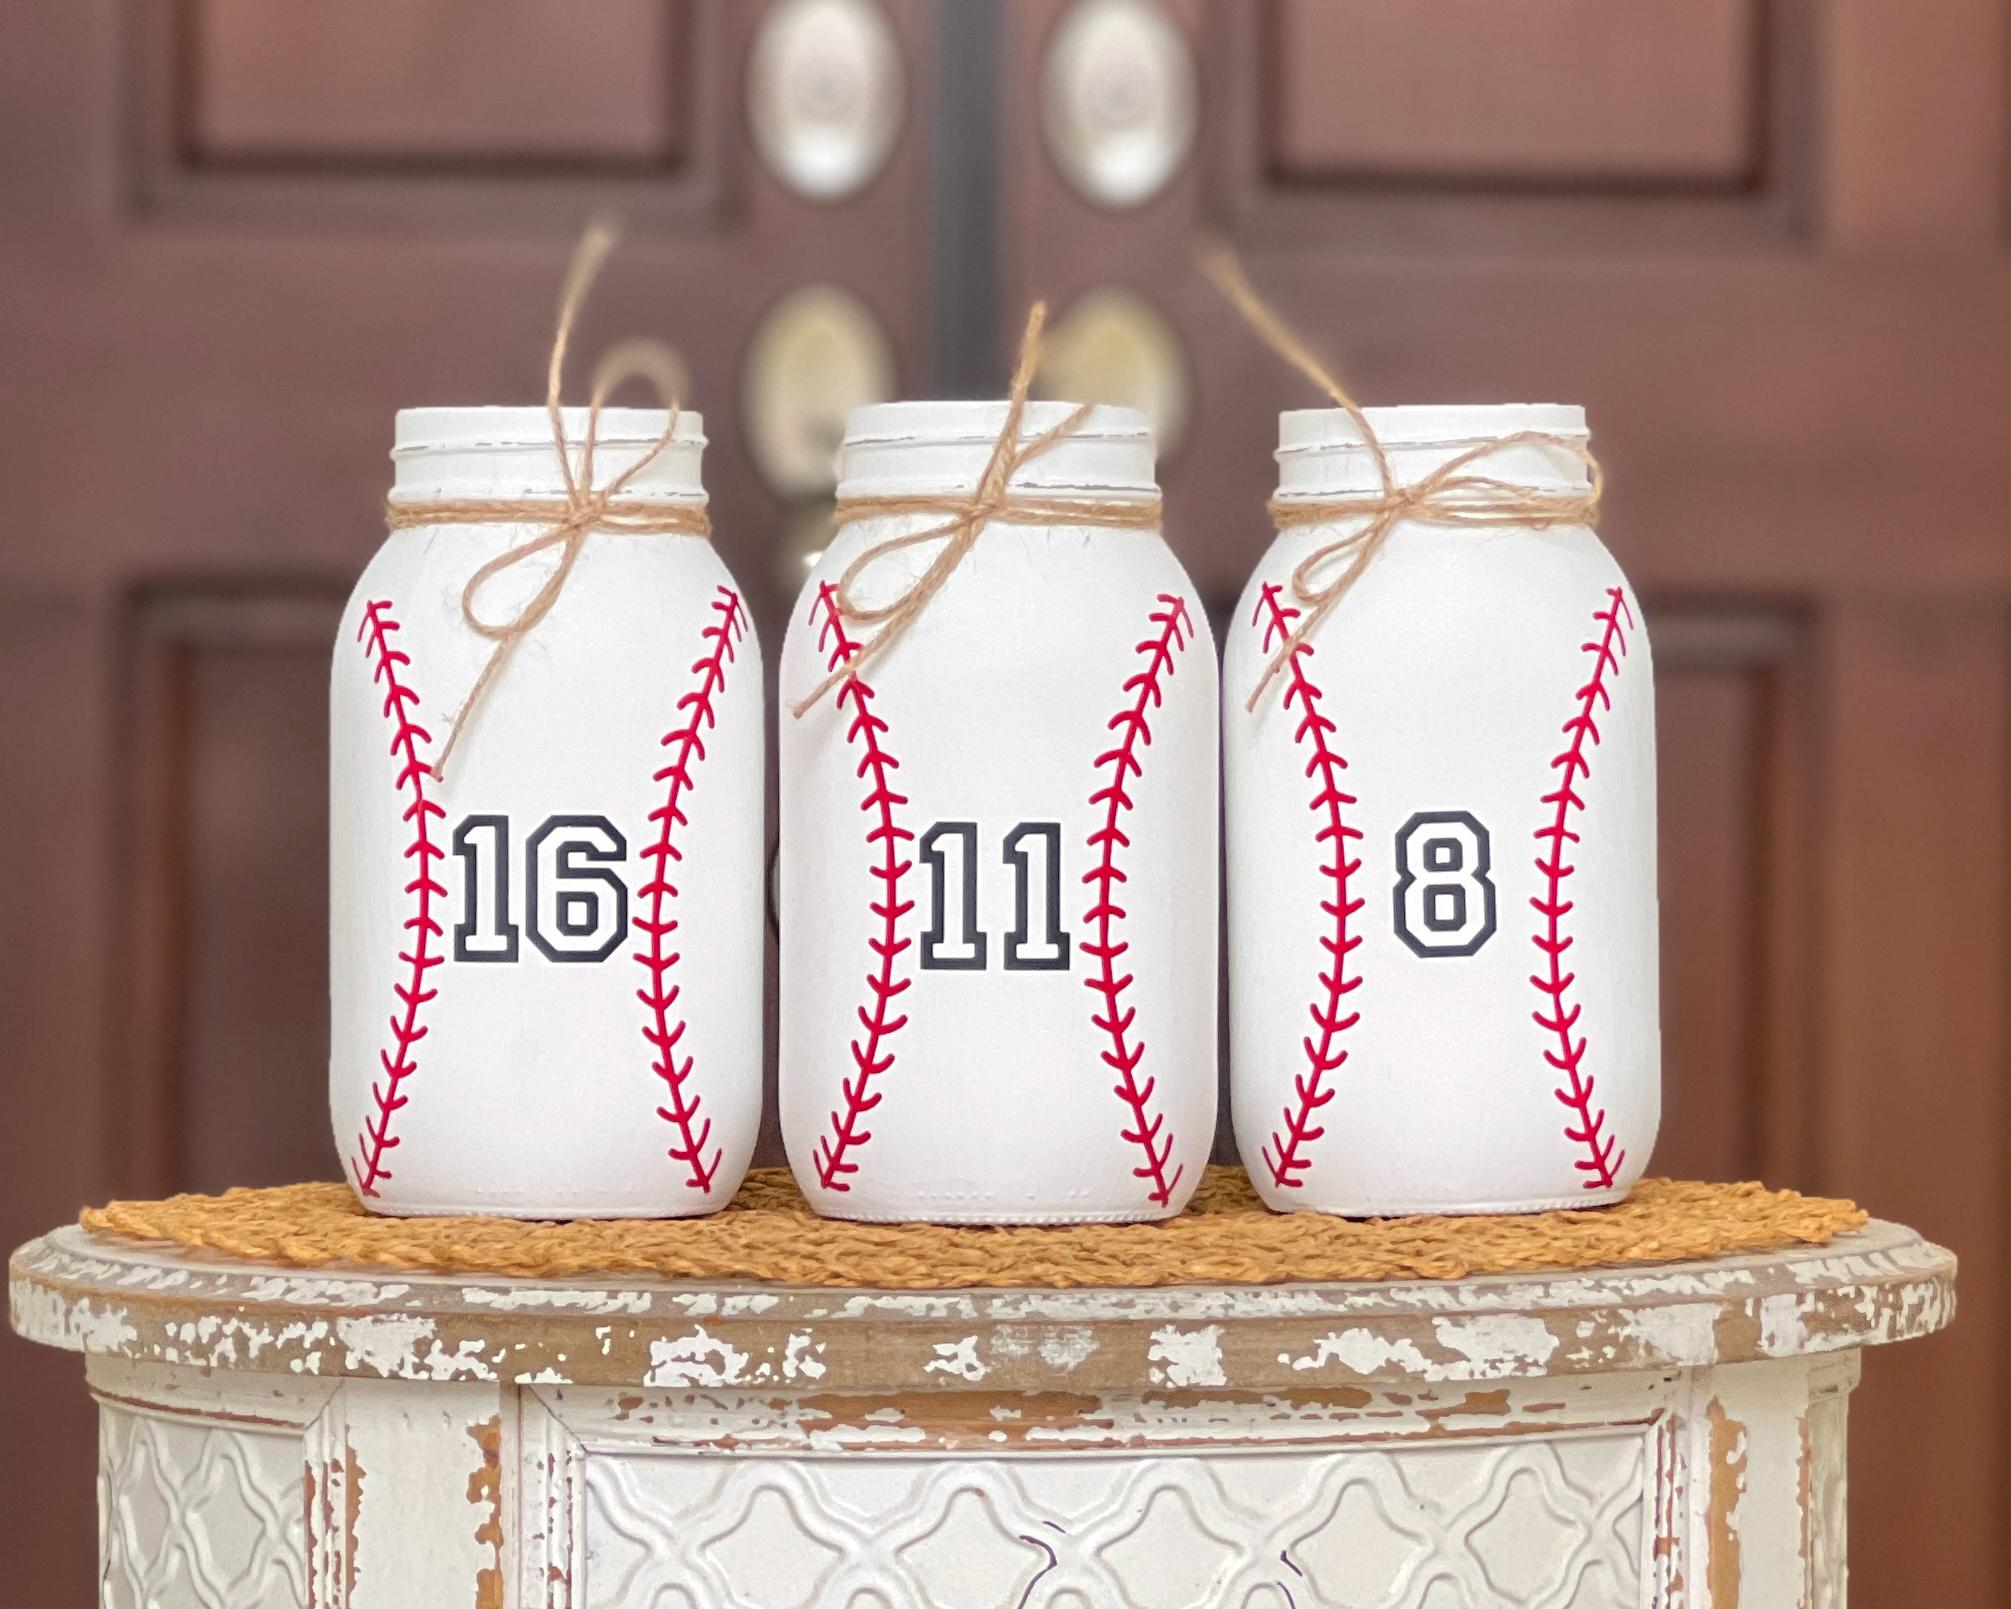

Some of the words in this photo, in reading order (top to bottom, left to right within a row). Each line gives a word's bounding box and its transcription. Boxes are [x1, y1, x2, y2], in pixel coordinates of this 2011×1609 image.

[453, 814, 629, 963] 16
[919, 821, 1071, 971] 11
[1393, 810, 1498, 958] 8
